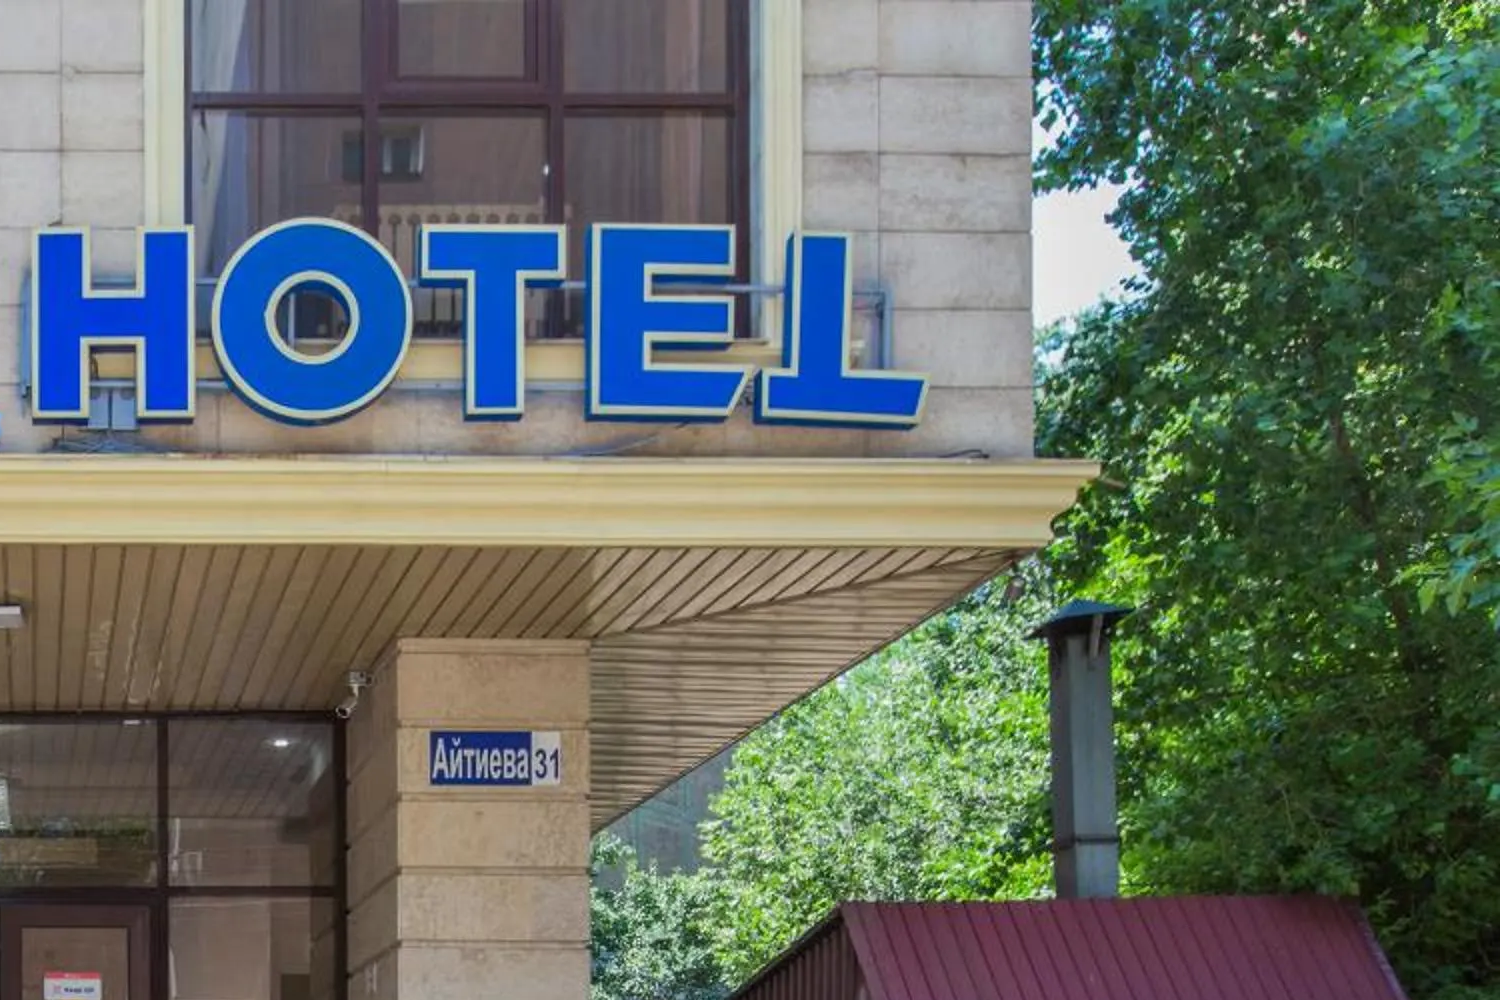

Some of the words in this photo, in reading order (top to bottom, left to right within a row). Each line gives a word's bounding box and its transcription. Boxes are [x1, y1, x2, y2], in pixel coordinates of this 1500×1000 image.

[29, 217, 931, 428] HOTEL
[432, 736, 529, 780] Айтиева
[534, 747, 560, 780] 31
